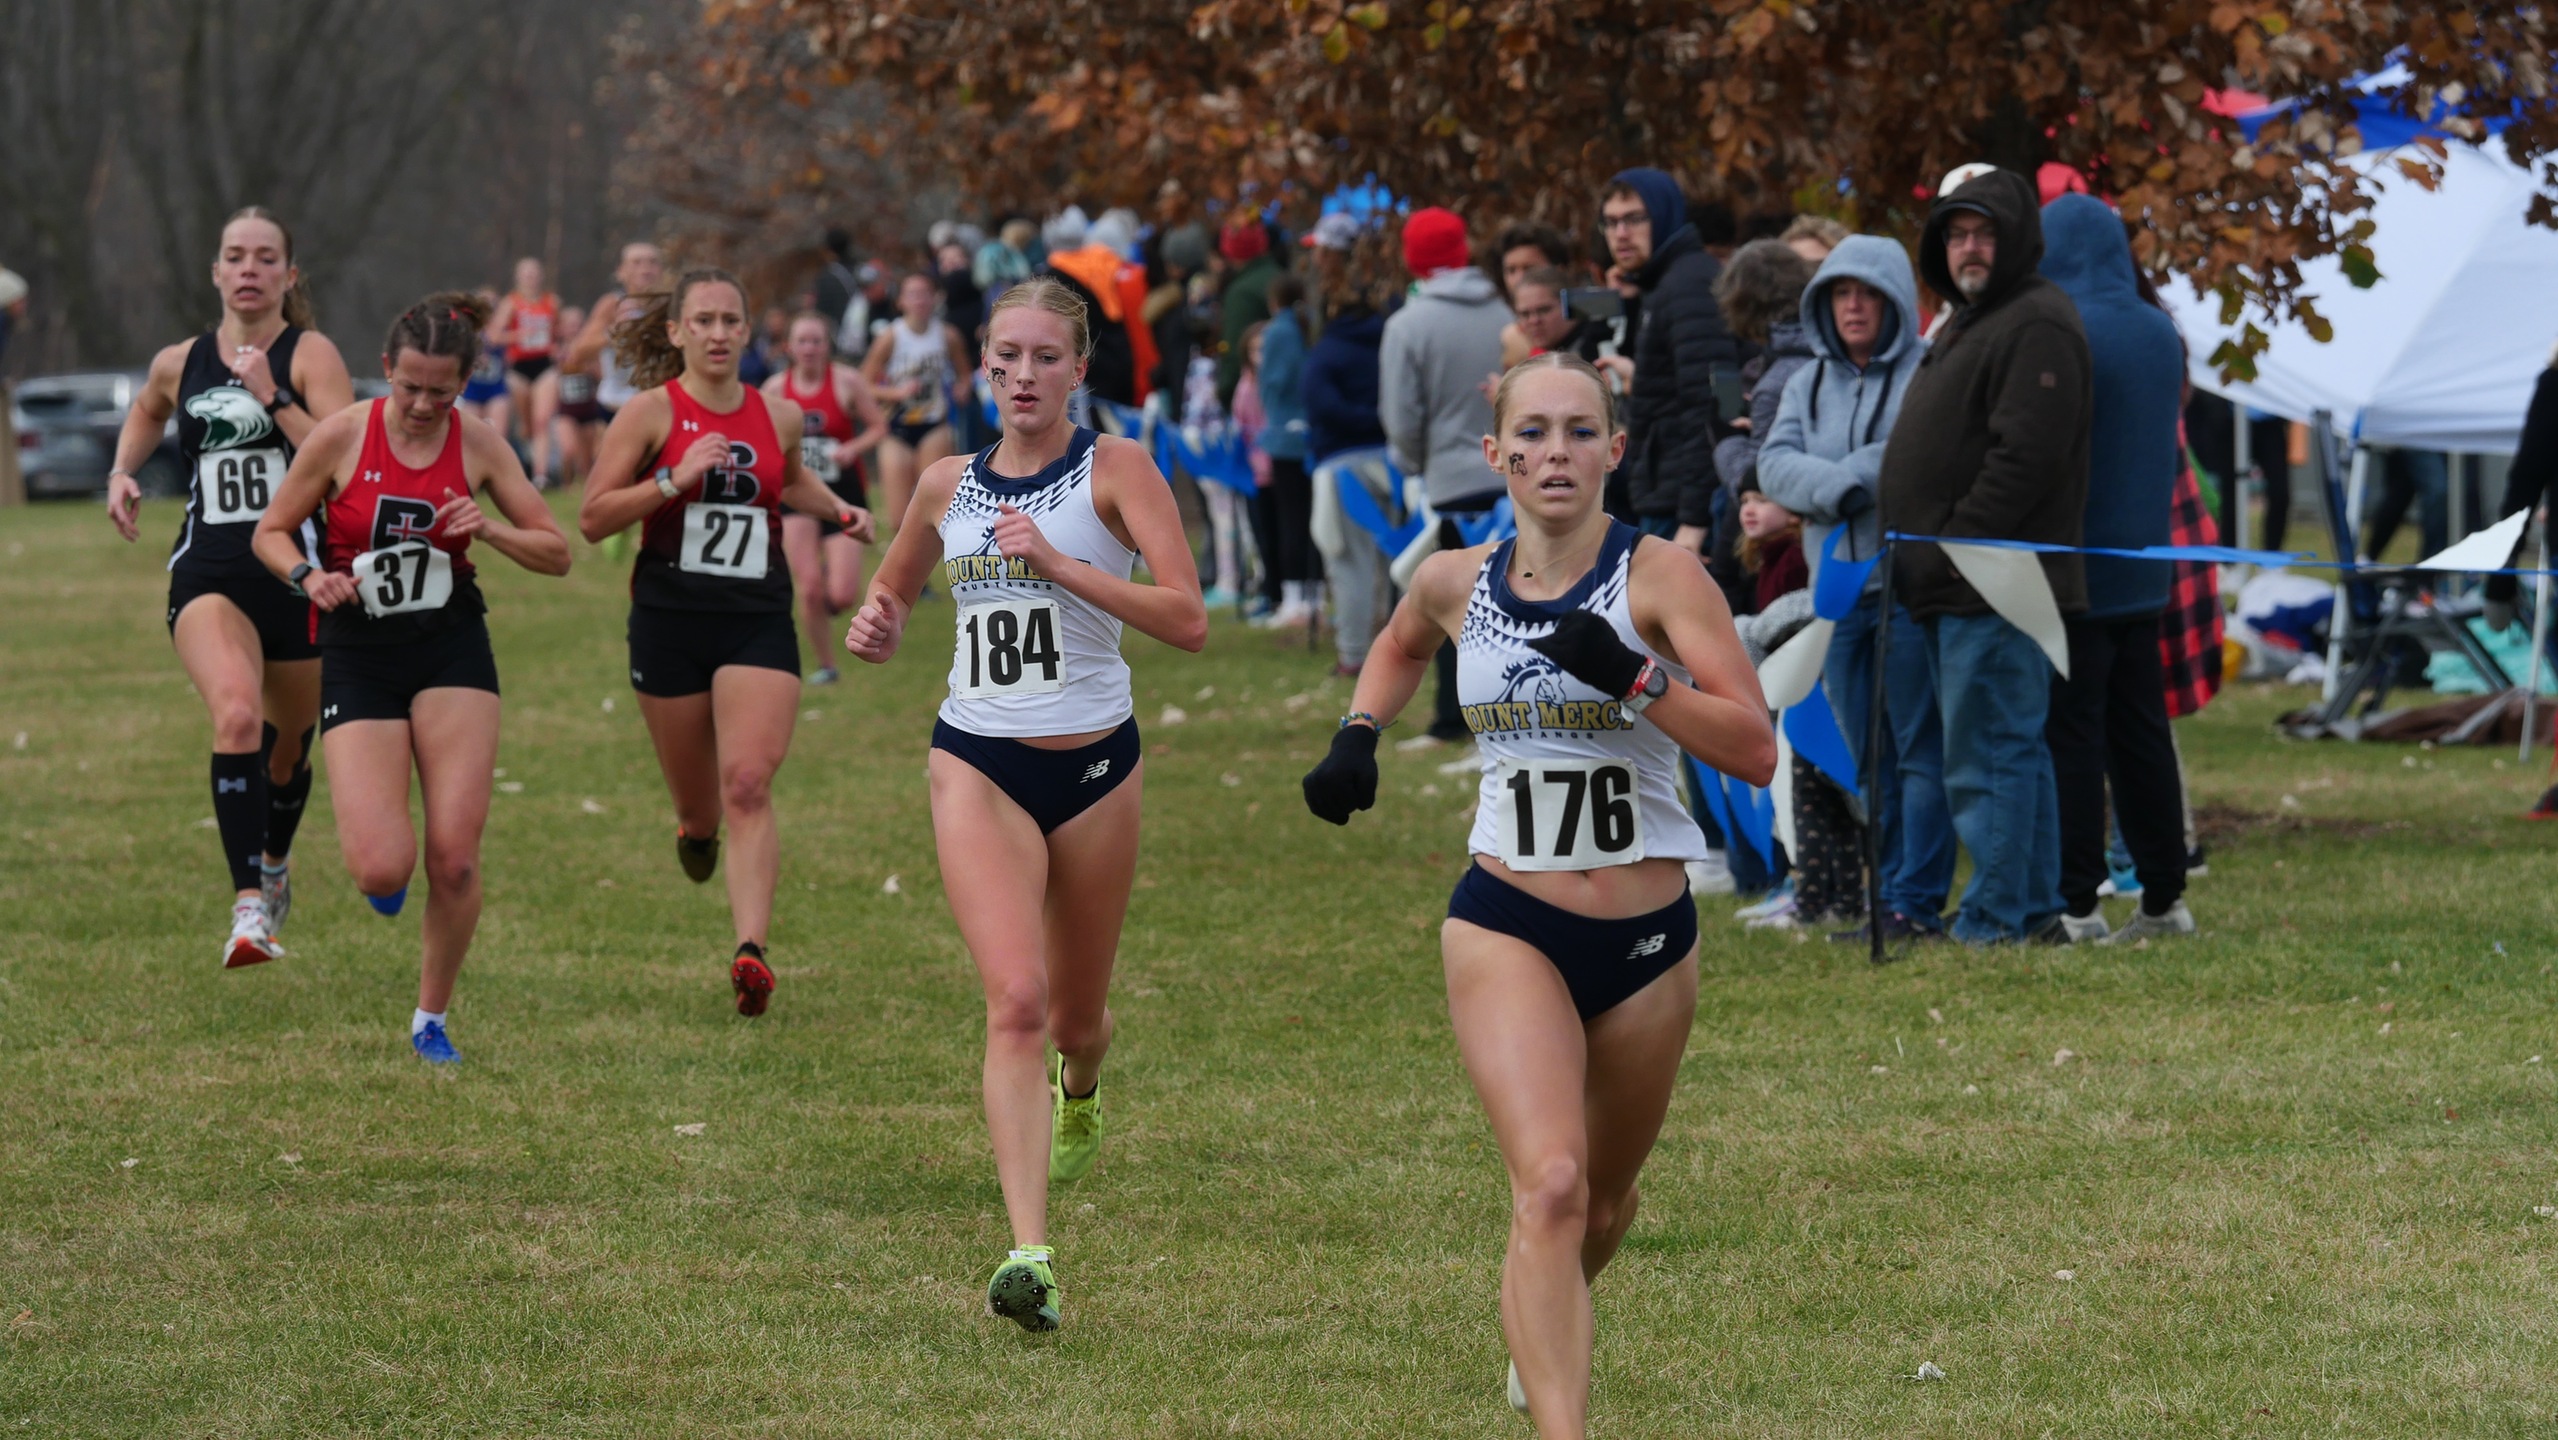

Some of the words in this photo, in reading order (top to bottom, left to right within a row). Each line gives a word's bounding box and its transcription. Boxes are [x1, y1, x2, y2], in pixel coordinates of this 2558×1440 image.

[217, 455, 269, 513] 66
[700, 510, 754, 568] 27
[373, 547, 431, 608] 37
[960, 581, 1053, 593] MUSTANGS
[965, 607, 1061, 688] 184
[1487, 730, 1594, 743] MUSTANGS
[1506, 765, 1635, 858] 176
